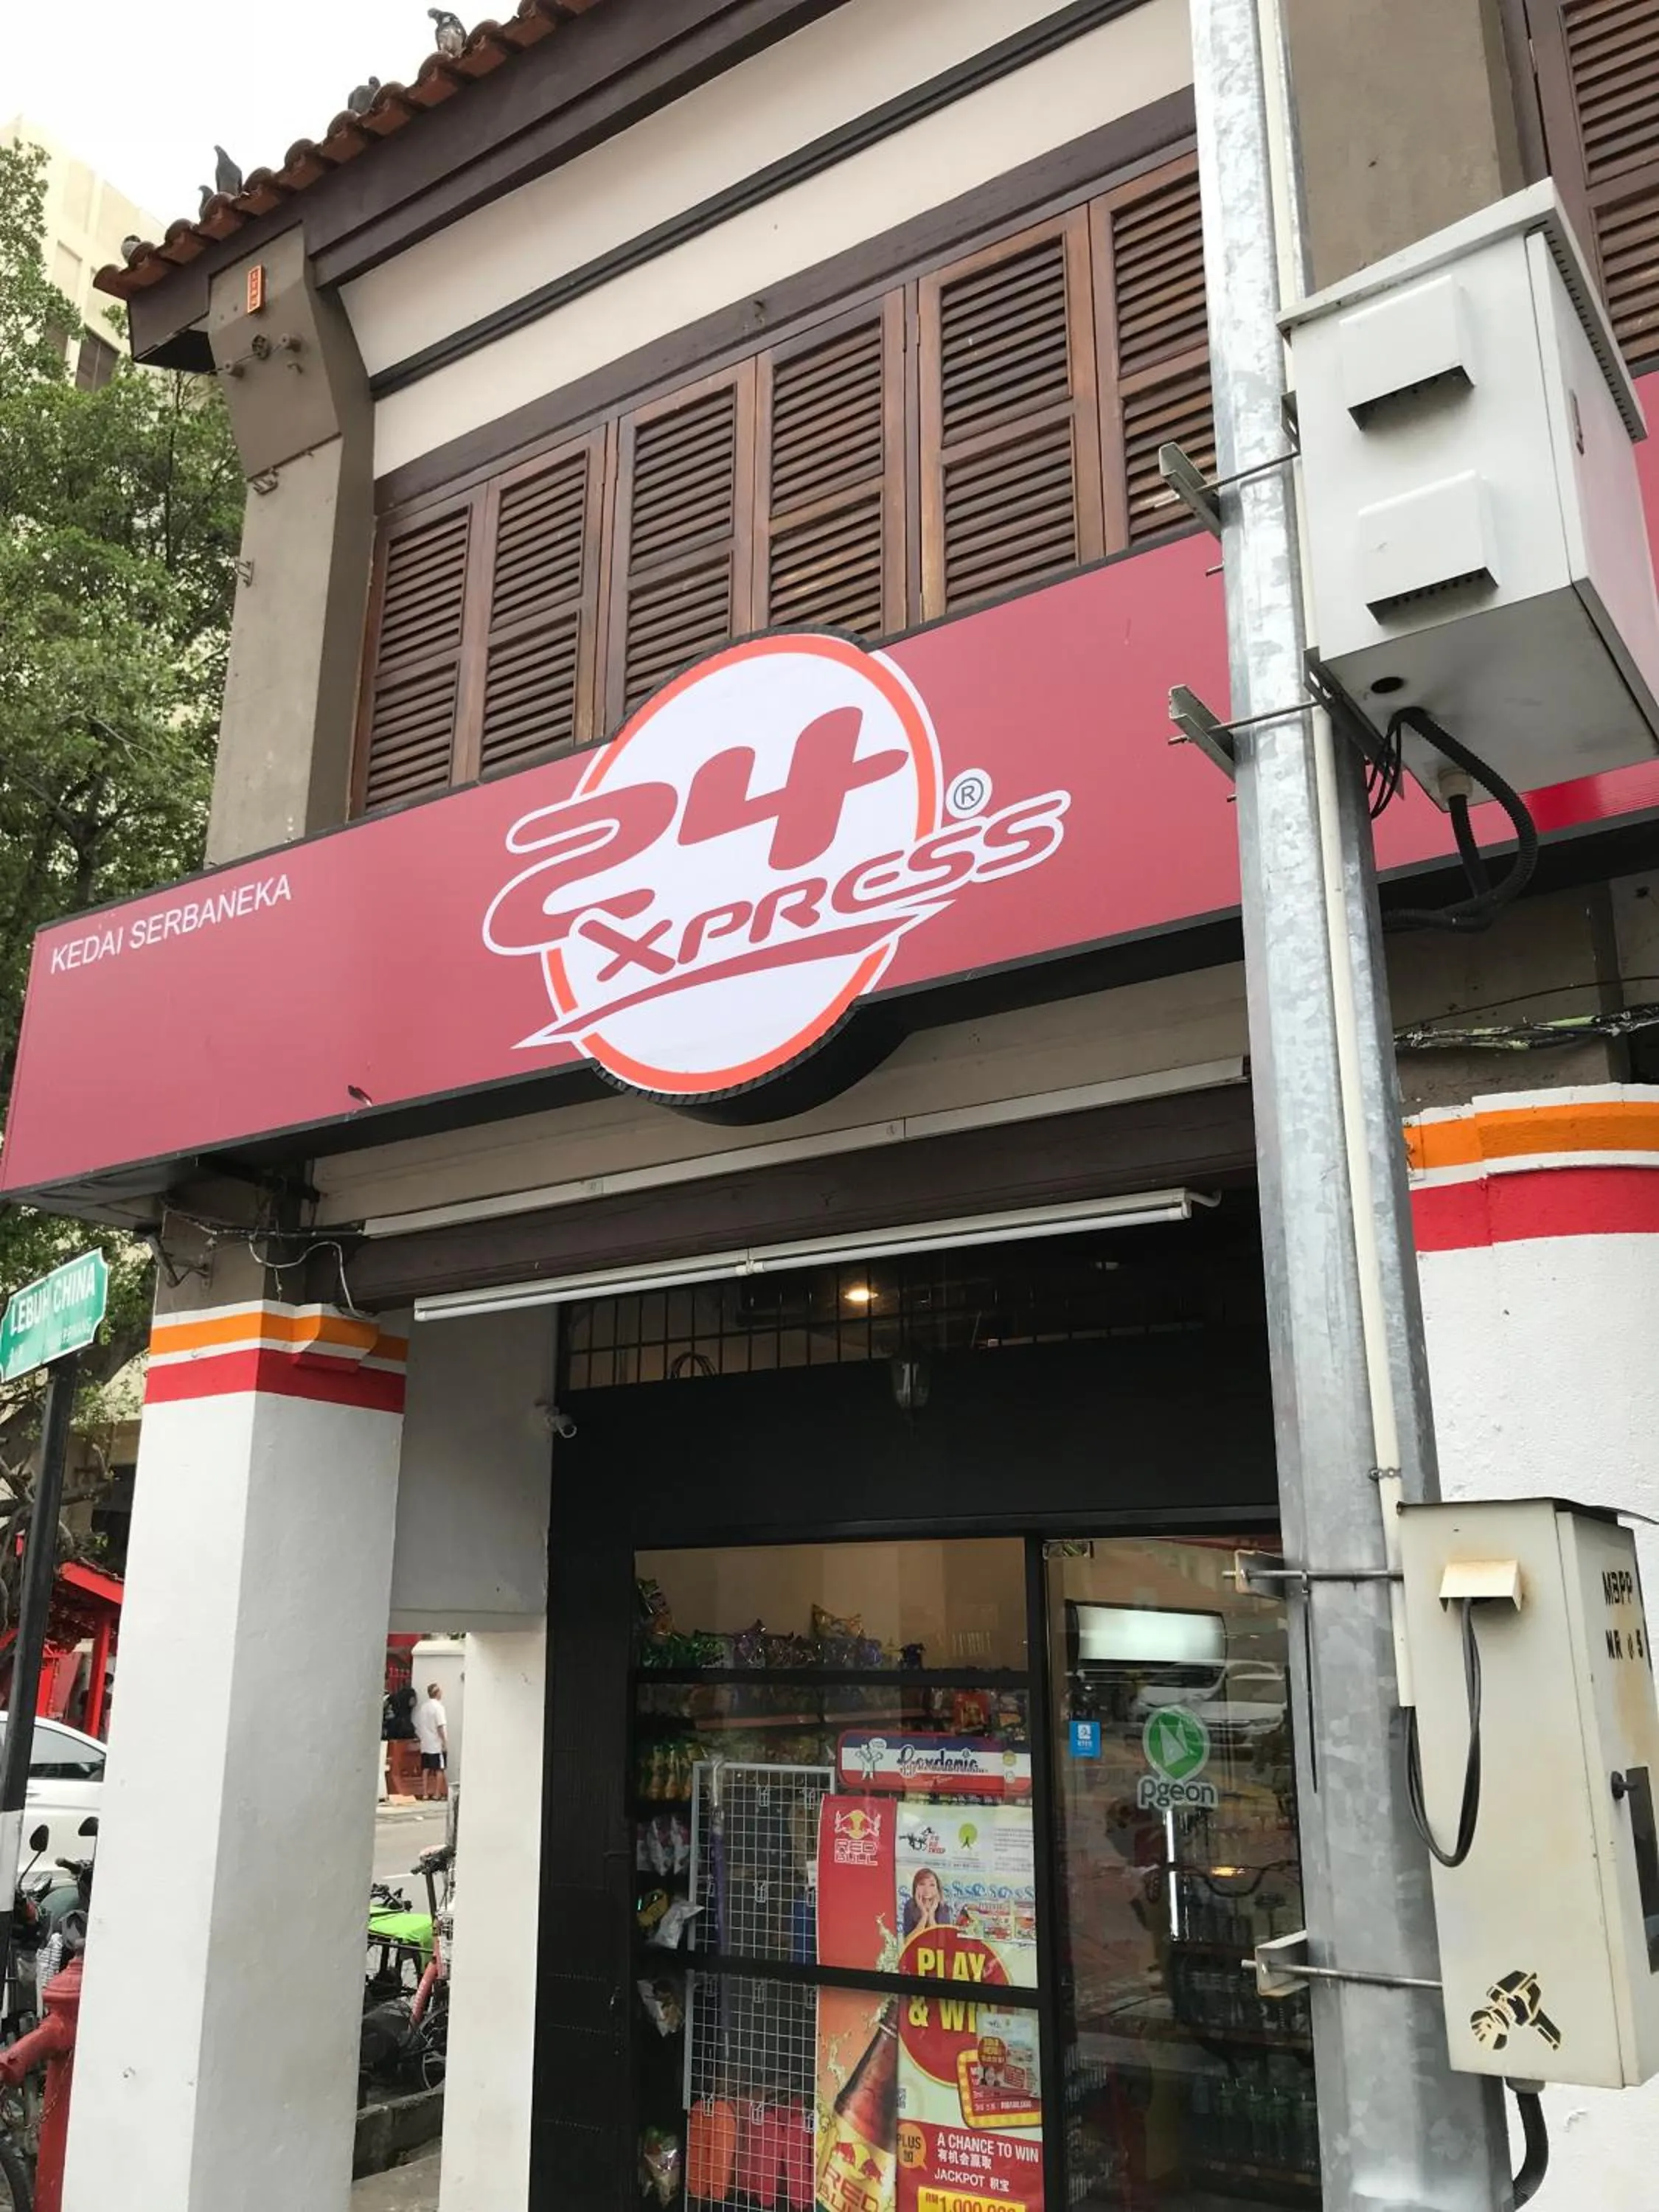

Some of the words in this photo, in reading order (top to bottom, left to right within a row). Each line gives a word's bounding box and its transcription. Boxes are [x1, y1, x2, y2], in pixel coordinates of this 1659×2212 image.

[487, 704, 910, 949] 24
[50, 937, 122, 974] KEDAI
[129, 874, 292, 950] SERBANEKA
[10, 1281, 52, 1336] LEBUH
[53, 1262, 96, 1313] CHINA
[835, 1838, 877, 1854] RED
[918, 1947, 986, 1983] PLAY
[908, 1995, 929, 2028] &
[939, 1999, 998, 2033] WI
[897, 2133, 921, 2149] PLUS
[937, 2132, 946, 2147] A
[947, 2133, 995, 2155] CHANCE
[997, 2142, 1012, 2159] TO
[1015, 2144, 1039, 2163] WIN
[934, 2168, 985, 2188] JACKPOT
